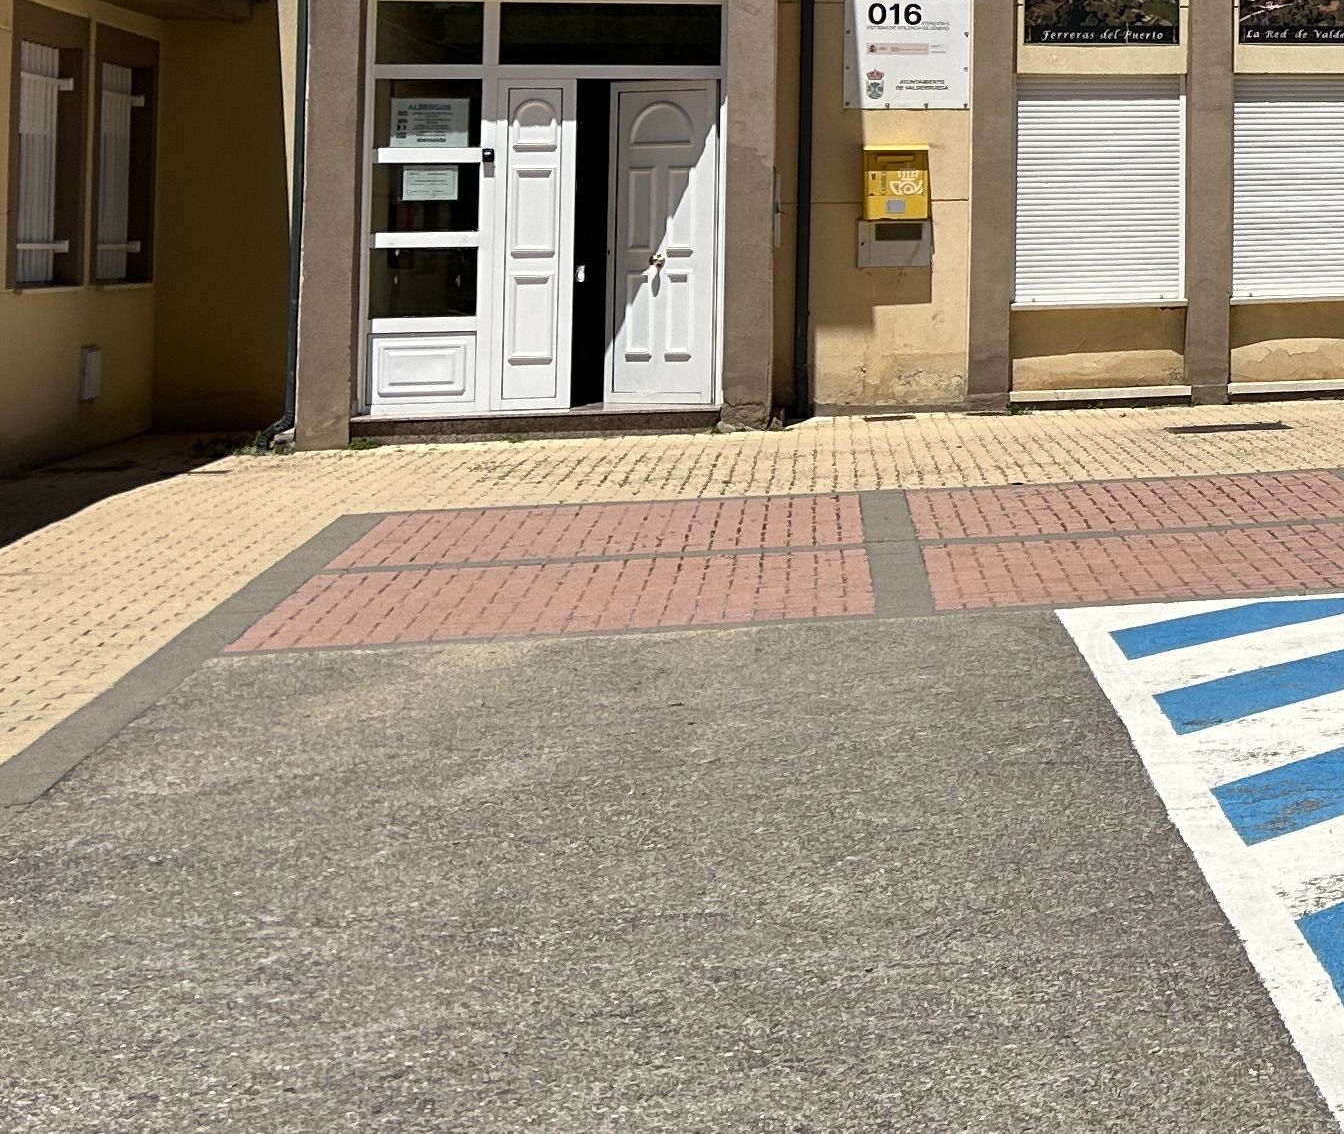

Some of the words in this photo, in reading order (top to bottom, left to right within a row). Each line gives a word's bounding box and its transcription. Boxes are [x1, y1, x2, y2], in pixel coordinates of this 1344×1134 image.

[868, 3, 922, 25] 016
[1041, 29, 1094, 41] Ferreras
[1100, 28, 1119, 39] del
[1124, 29, 1163, 41] Puerto
[1246, 29, 1260, 39] La
[1265, 29, 1289, 39] Red
[1295, 29, 1307, 39] de
